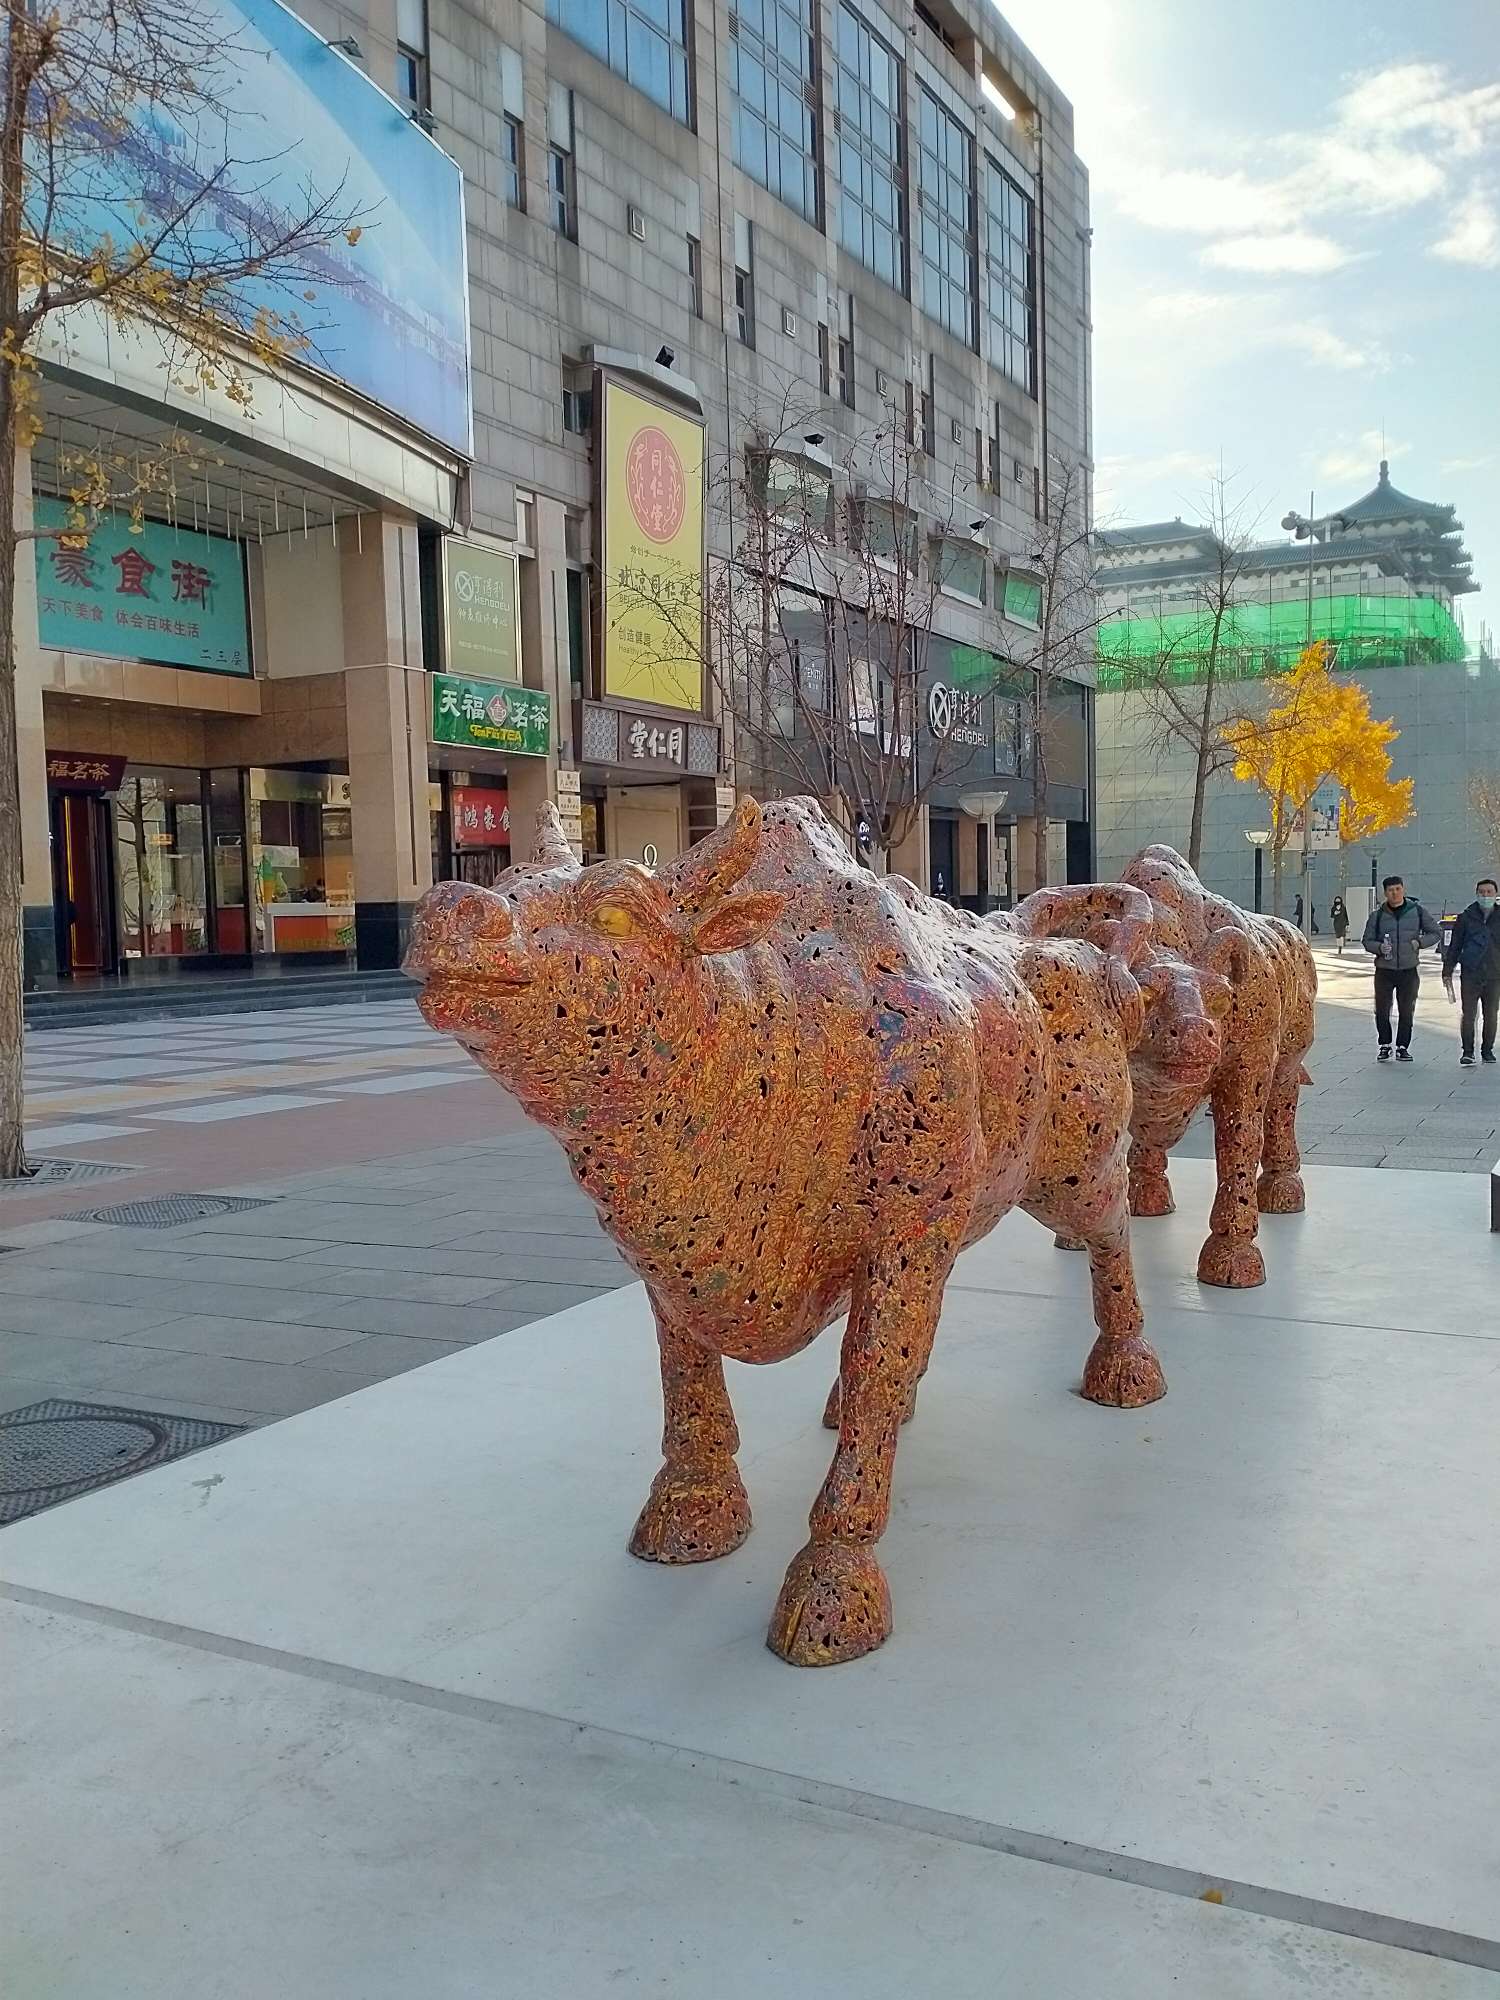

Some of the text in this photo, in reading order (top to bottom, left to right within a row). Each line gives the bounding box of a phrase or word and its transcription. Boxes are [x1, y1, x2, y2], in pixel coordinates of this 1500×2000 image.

[43, 597, 200, 639] 天下美食 体会百味生活
